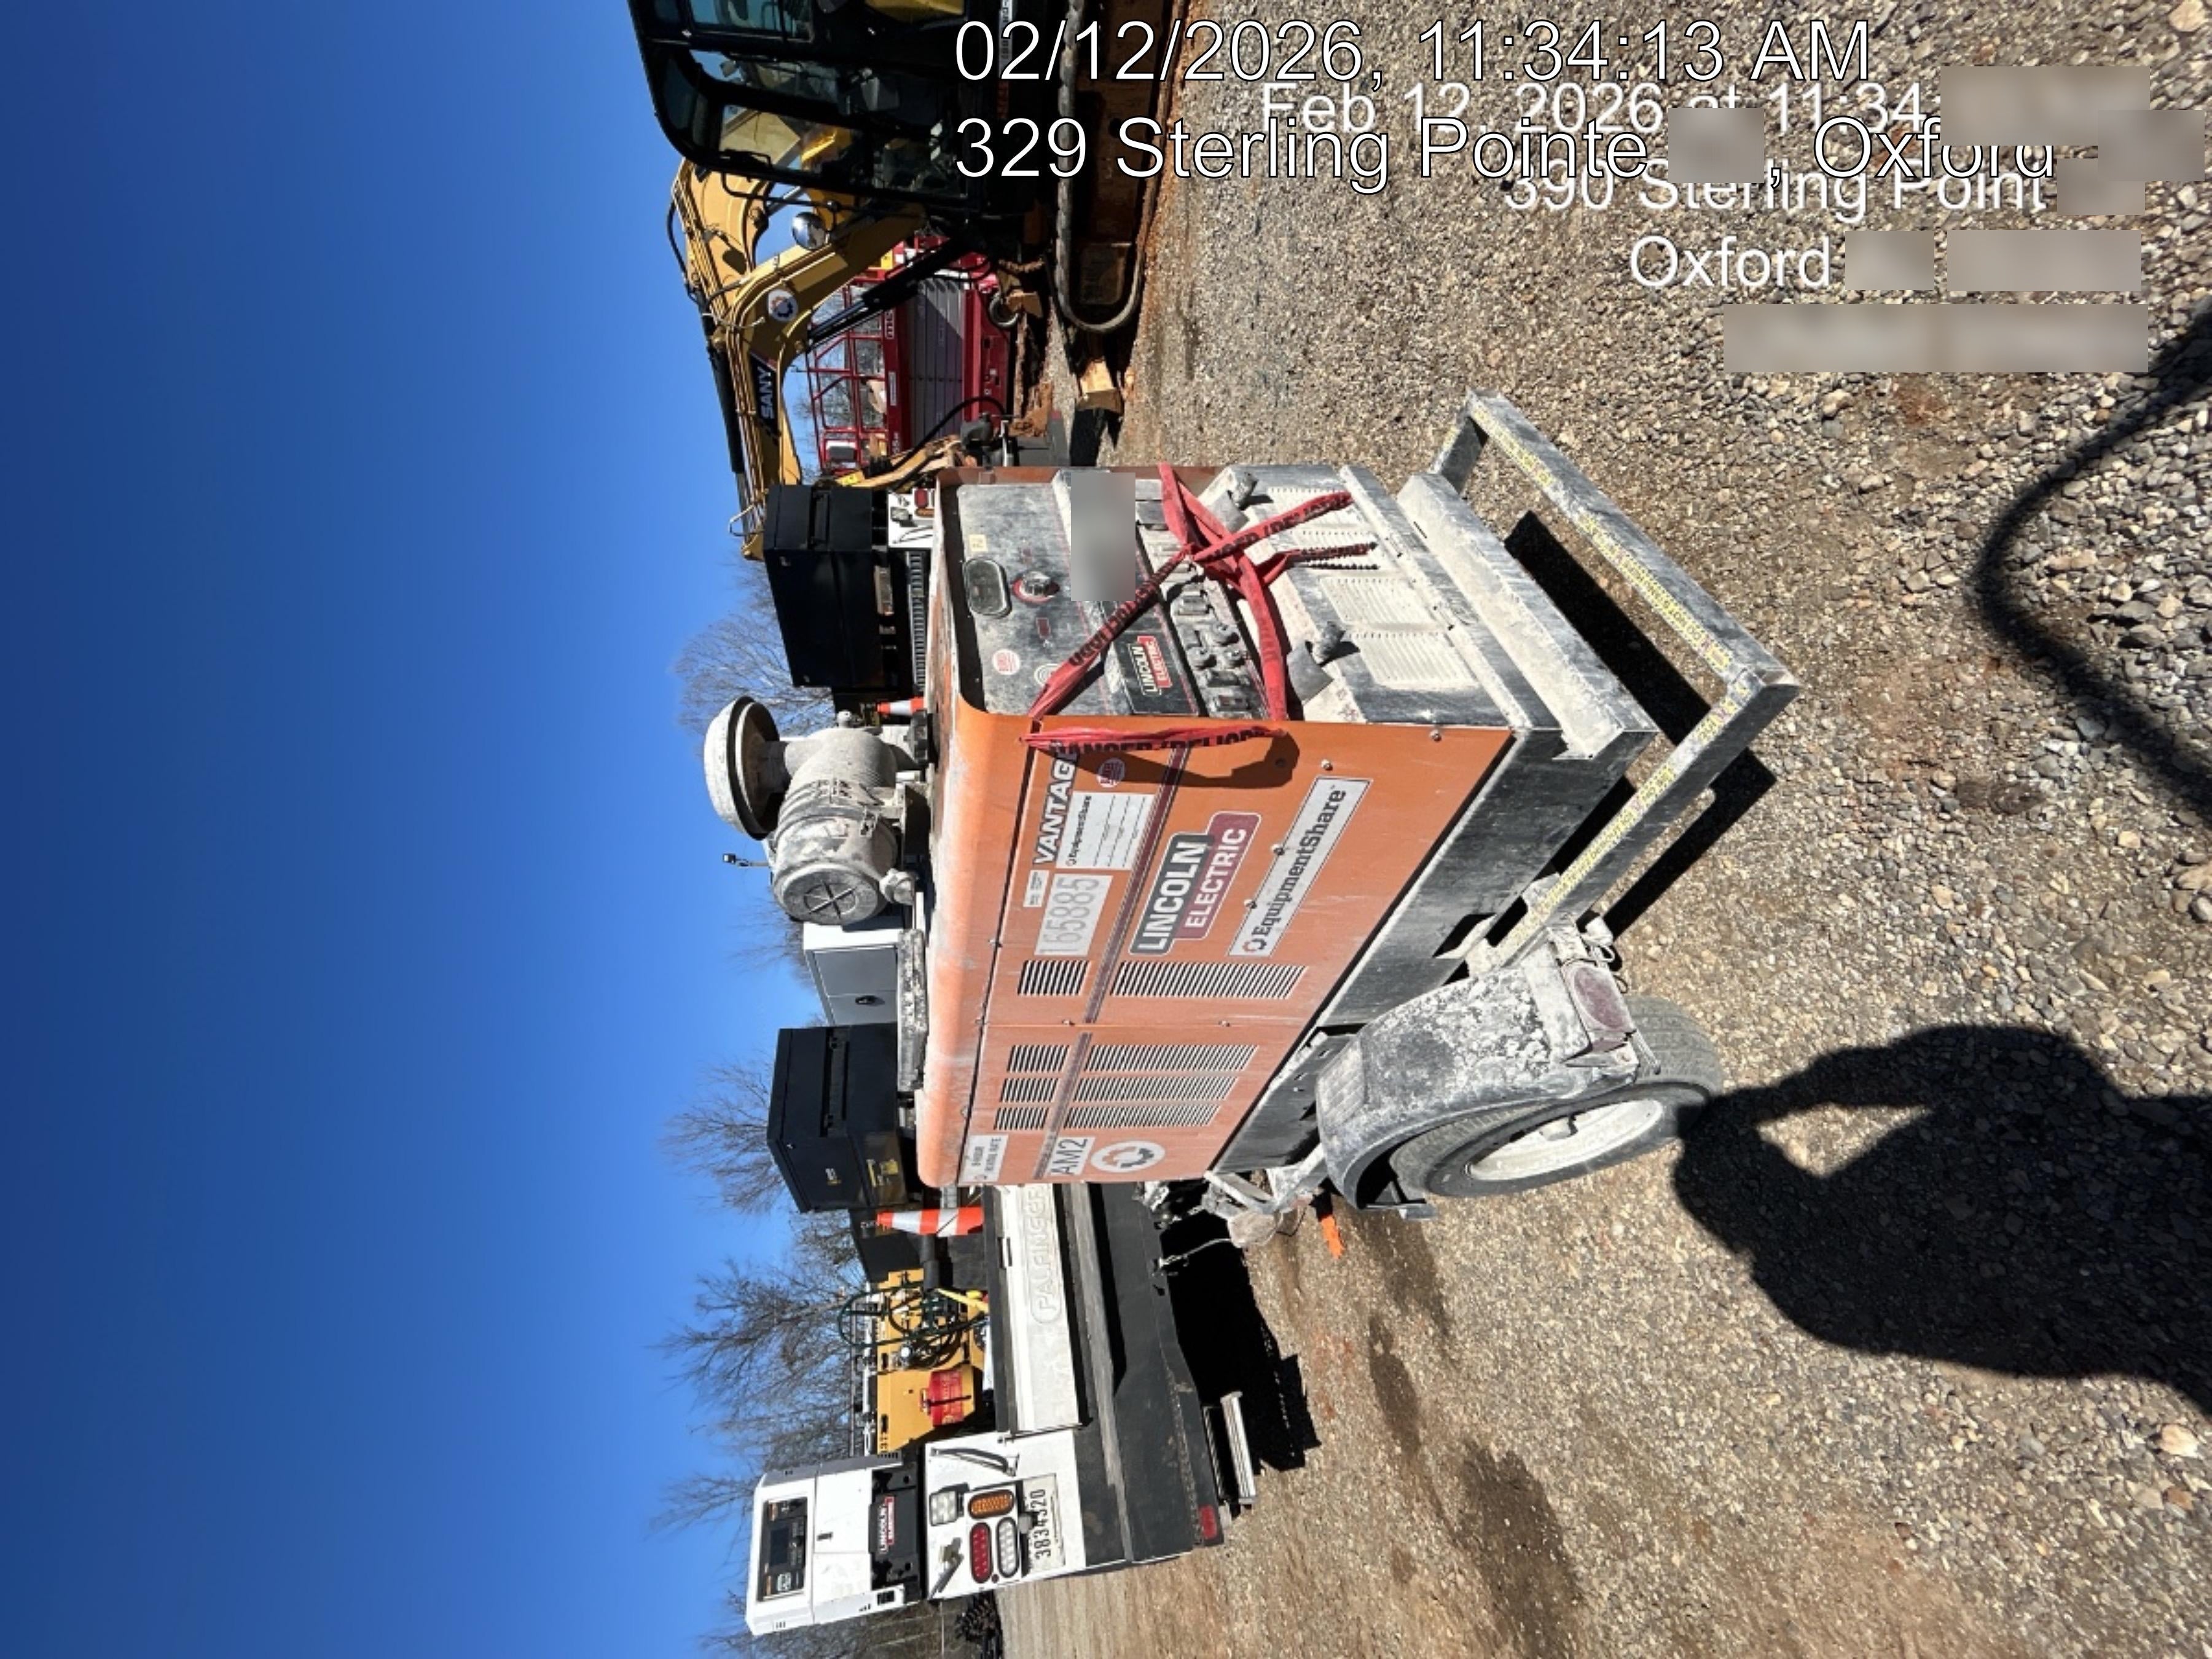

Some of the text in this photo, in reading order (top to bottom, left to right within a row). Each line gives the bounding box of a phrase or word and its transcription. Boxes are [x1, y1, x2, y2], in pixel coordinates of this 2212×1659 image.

[757, 366, 775, 419] SANY
[1131, 646, 1158, 692] LINCOLN
[1067, 795, 1092, 858] EquipmentShare
[1138, 841, 1207, 950] LINCOLN
[1185, 829, 1247, 928] ELECTRIC
[1250, 790, 1346, 937] EquipmentShare
[1038, 877, 1100, 954] 165885
[1049, 1138, 1088, 1175] AM2
